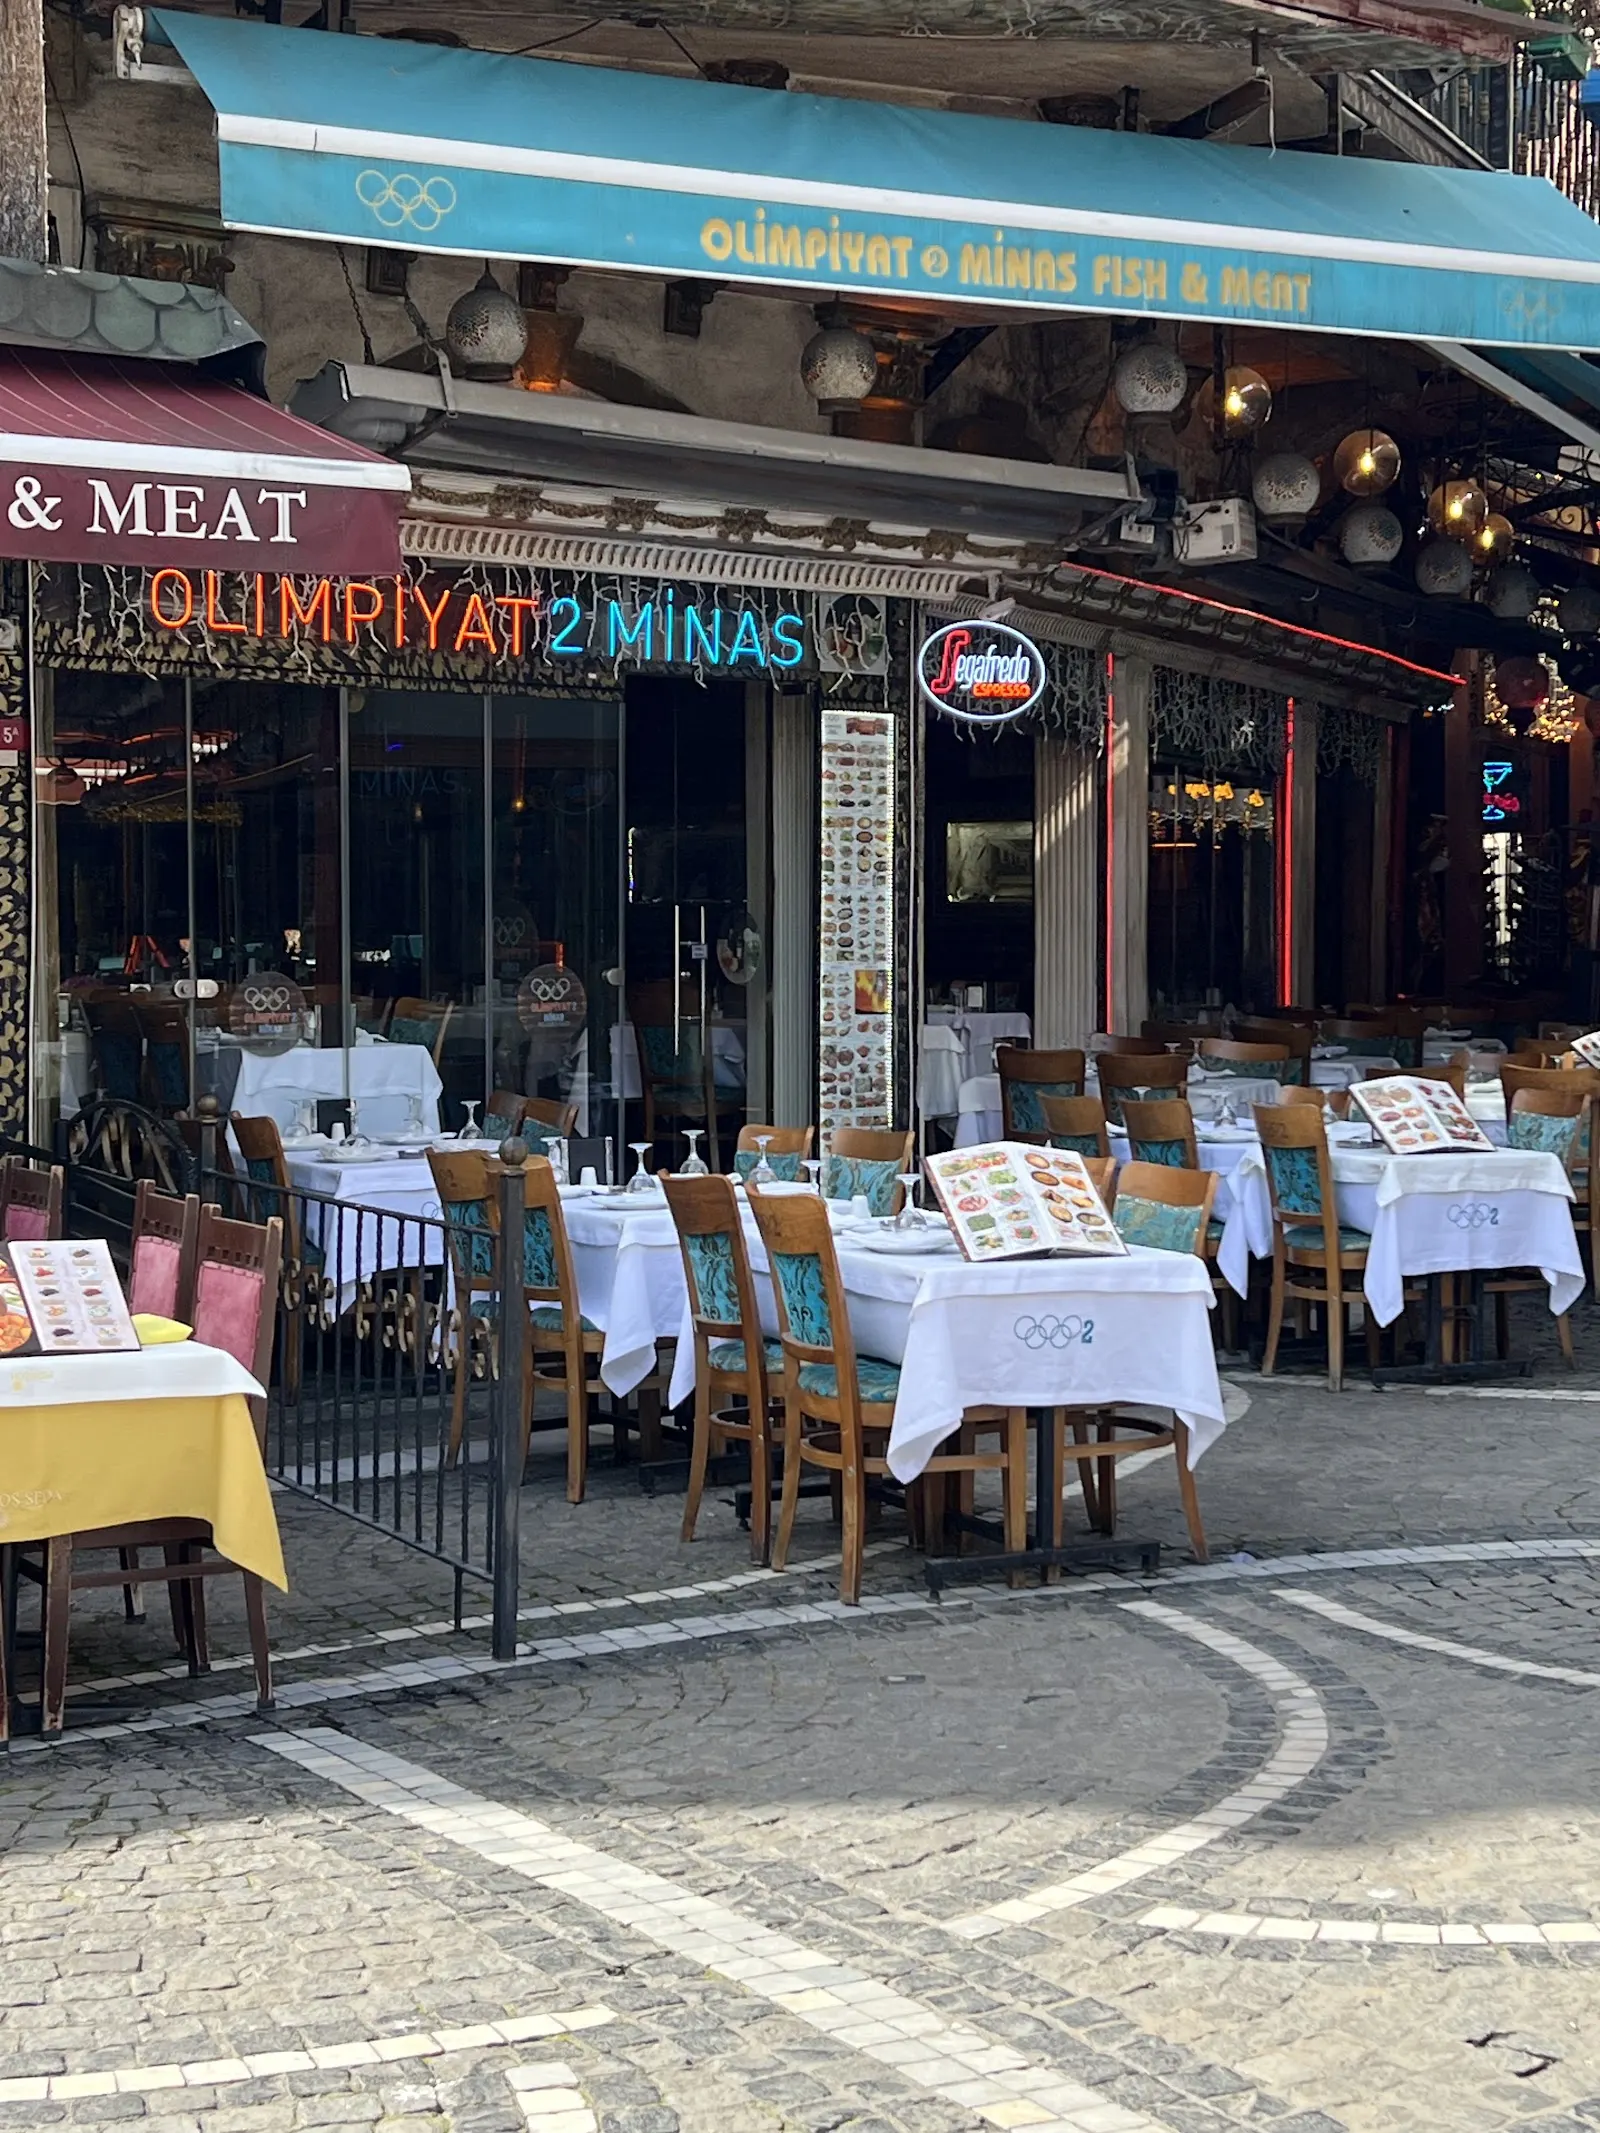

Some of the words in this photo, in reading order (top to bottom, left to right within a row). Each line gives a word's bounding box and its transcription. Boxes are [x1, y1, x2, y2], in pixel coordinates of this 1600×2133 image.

[700, 207, 913, 279] OLİMPİYAT
[959, 230, 1078, 292] MİNAS
[1092, 255, 1167, 300] FISH
[1180, 262, 1208, 304] &
[1220, 265, 1312, 313] MEAT
[7, 475, 63, 531] &
[86, 478, 307, 543] MEAT
[551, 597, 584, 653] 2
[608, 588, 804, 667] MİNAS
[930, 629, 1031, 695] Segafredo
[972, 683, 1031, 698] ESPRESSO
[1490, 1207, 1499, 1225] 2
[1081, 1319, 1094, 1343] 2
